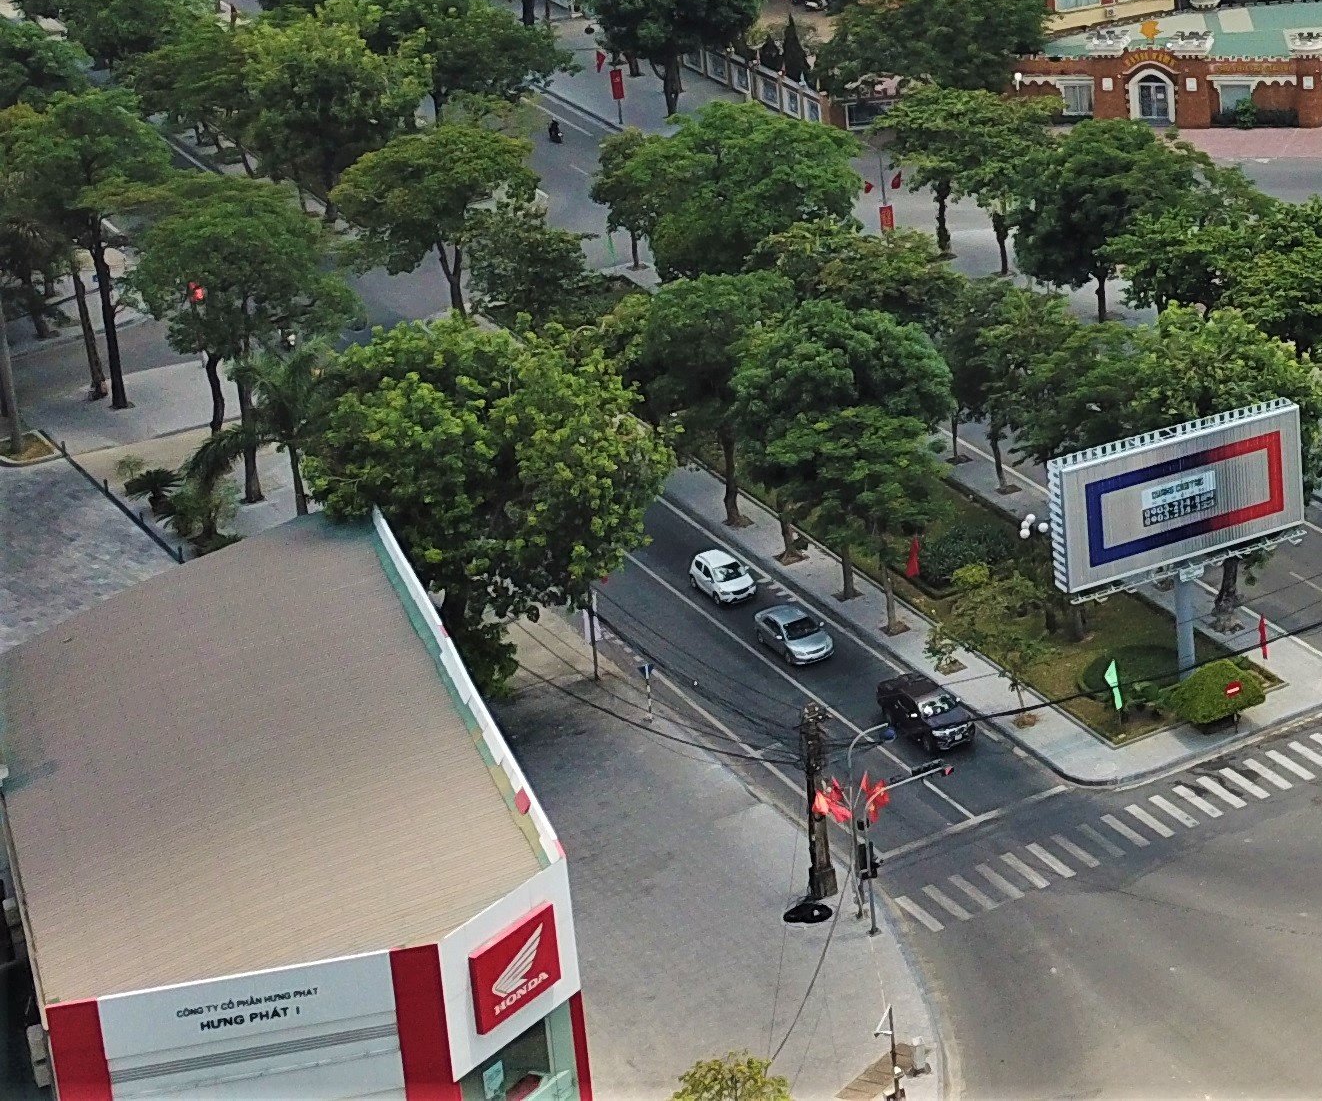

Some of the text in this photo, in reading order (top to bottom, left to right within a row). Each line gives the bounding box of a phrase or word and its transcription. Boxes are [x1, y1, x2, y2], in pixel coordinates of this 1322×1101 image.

[493, 972, 549, 1016] HONDA
[176, 1006, 204, 1018] CÔNG
[205, 1003, 219, 1013] TY
[200, 1015, 245, 1031] HƯNG
[249, 1005, 289, 1023] PHÁT
